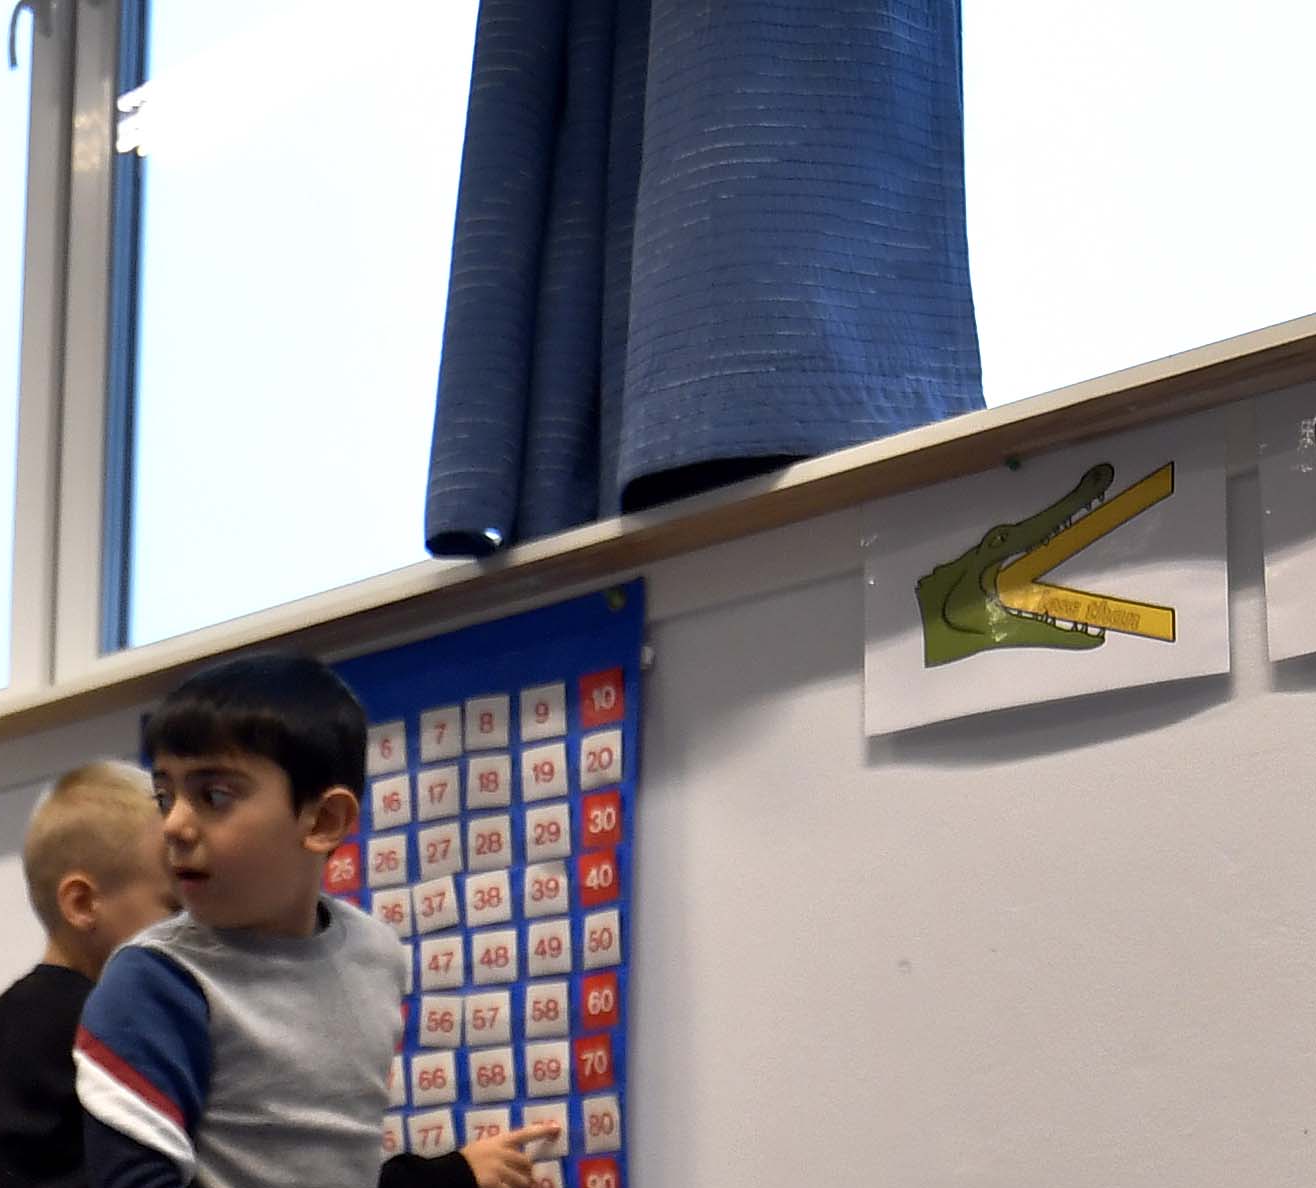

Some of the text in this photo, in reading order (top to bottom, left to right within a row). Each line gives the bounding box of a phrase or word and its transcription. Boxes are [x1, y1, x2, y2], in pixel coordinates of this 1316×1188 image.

[592, 686, 616, 713] 10
[479, 713, 493, 734] 8
[535, 703, 549, 723] 9
[434, 723, 447, 744] 7
[379, 739, 392, 760] 6
[587, 747, 613, 772] 20
[478, 771, 499, 793] 18
[533, 762, 555, 783] 19
[382, 791, 401, 812] 16
[428, 783, 448, 805] 17
[589, 807, 616, 833] 30
[476, 832, 502, 855] 28
[534, 822, 560, 845] 29
[375, 851, 398, 873] 26
[427, 840, 451, 863] 27
[586, 865, 613, 889] 40
[474, 888, 502, 910] 38
[532, 879, 559, 901] 39
[421, 893, 446, 917] 37
[535, 937, 562, 959] 49
[589, 928, 613, 953] 50
[429, 952, 453, 973] 47
[480, 946, 509, 968] 48
[532, 1000, 558, 1021] 58
[588, 990, 613, 1015] 60
[427, 1011, 453, 1032] 56
[473, 1008, 498, 1030] 57
[533, 1059, 561, 1081] 69
[582, 1051, 608, 1076] 70
[419, 1069, 446, 1090] 66
[477, 1064, 505, 1088] 68
[589, 1113, 613, 1137] 80
[419, 1126, 443, 1147] 77
